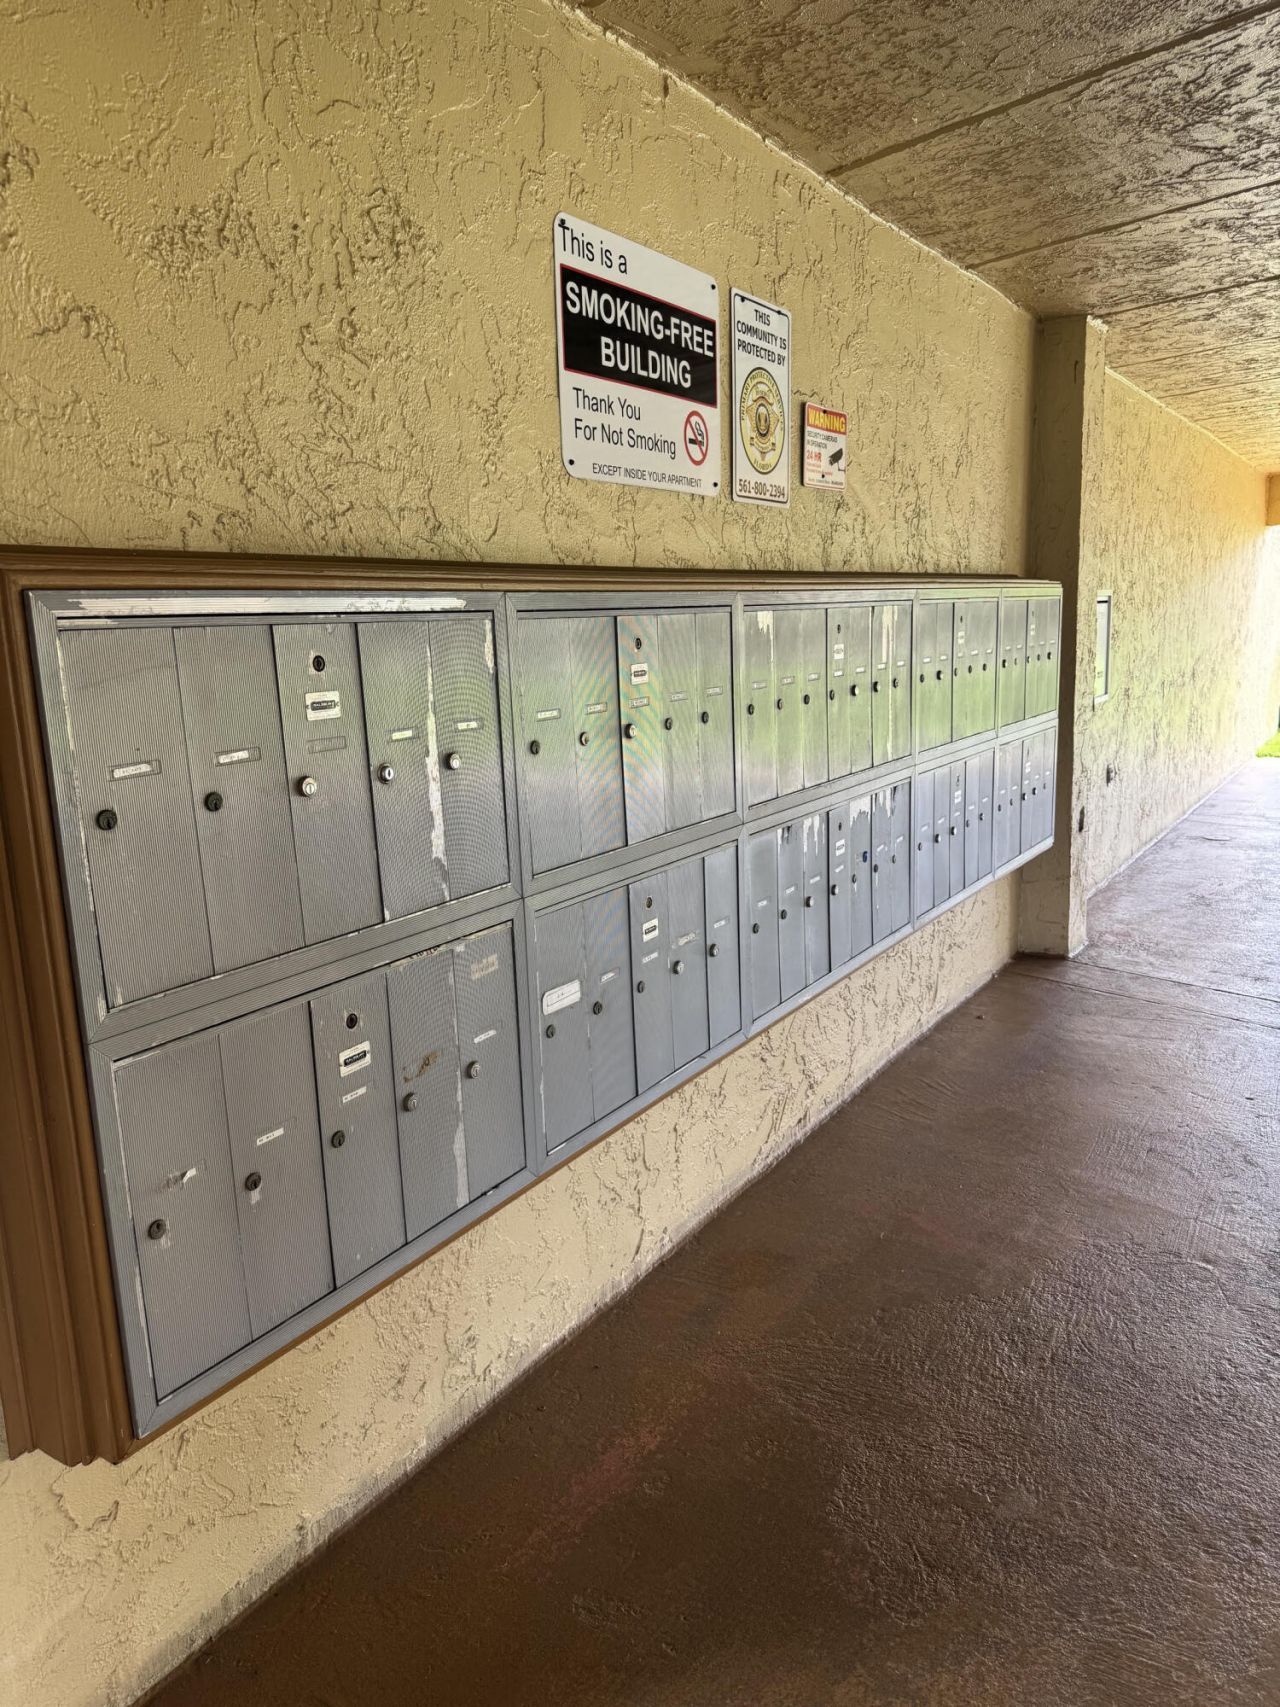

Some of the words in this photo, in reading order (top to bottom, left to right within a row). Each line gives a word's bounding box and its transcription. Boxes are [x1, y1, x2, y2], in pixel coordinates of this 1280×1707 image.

[559, 224, 595, 262] This
[600, 240, 613, 269] is
[618, 253, 628, 275] a
[565, 281, 714, 358] SMOKING-FREE
[754, 309, 771, 327] THIS
[737, 320, 778, 348] COMMUNITY
[779, 336, 787, 350] IS
[600, 336, 692, 388] BUILDING
[737, 338, 776, 364] PROTECTED
[777, 354, 786, 367] BY
[573, 386, 615, 416] Thank
[618, 396, 641, 421] You
[808, 407, 846, 433] WARNING
[574, 418, 597, 441] For
[600, 423, 623, 446] Not
[627, 428, 676, 460] Smoking
[806, 449, 813, 460] 24
[592, 462, 622, 477] EXCEPT
[624, 467, 647, 481] INSIDE
[647, 470, 668, 484] YOUR
[668, 473, 703, 489] APARTMENT
[738, 478, 785, 500] 561-800-2394
